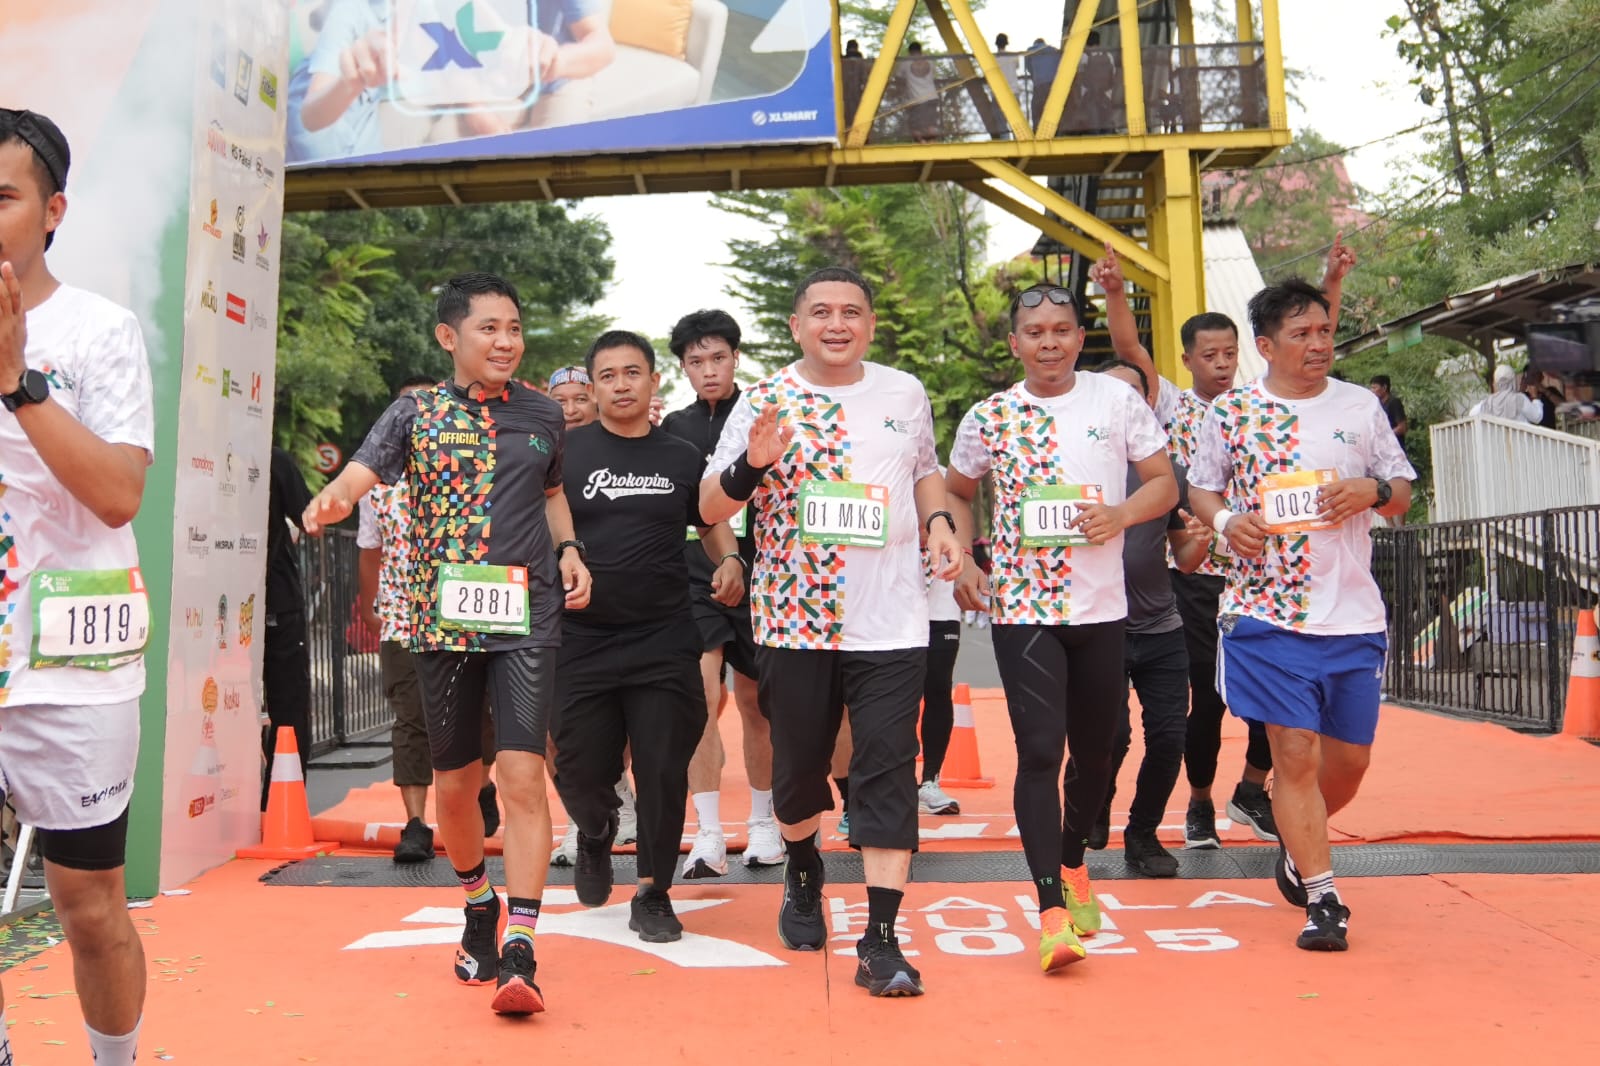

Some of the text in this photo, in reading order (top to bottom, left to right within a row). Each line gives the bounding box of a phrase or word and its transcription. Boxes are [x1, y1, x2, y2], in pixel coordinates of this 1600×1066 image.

[419, 1, 505, 71] XL
[768, 110, 818, 123] XLSMART
[439, 431, 481, 446] OFFICIAL
[583, 467, 675, 500] Prokopim
[807, 501, 881, 531] 01 MKS
[1039, 505, 1081, 529] 019
[458, 586, 510, 616] 2881
[68, 604, 130, 645] 1819
